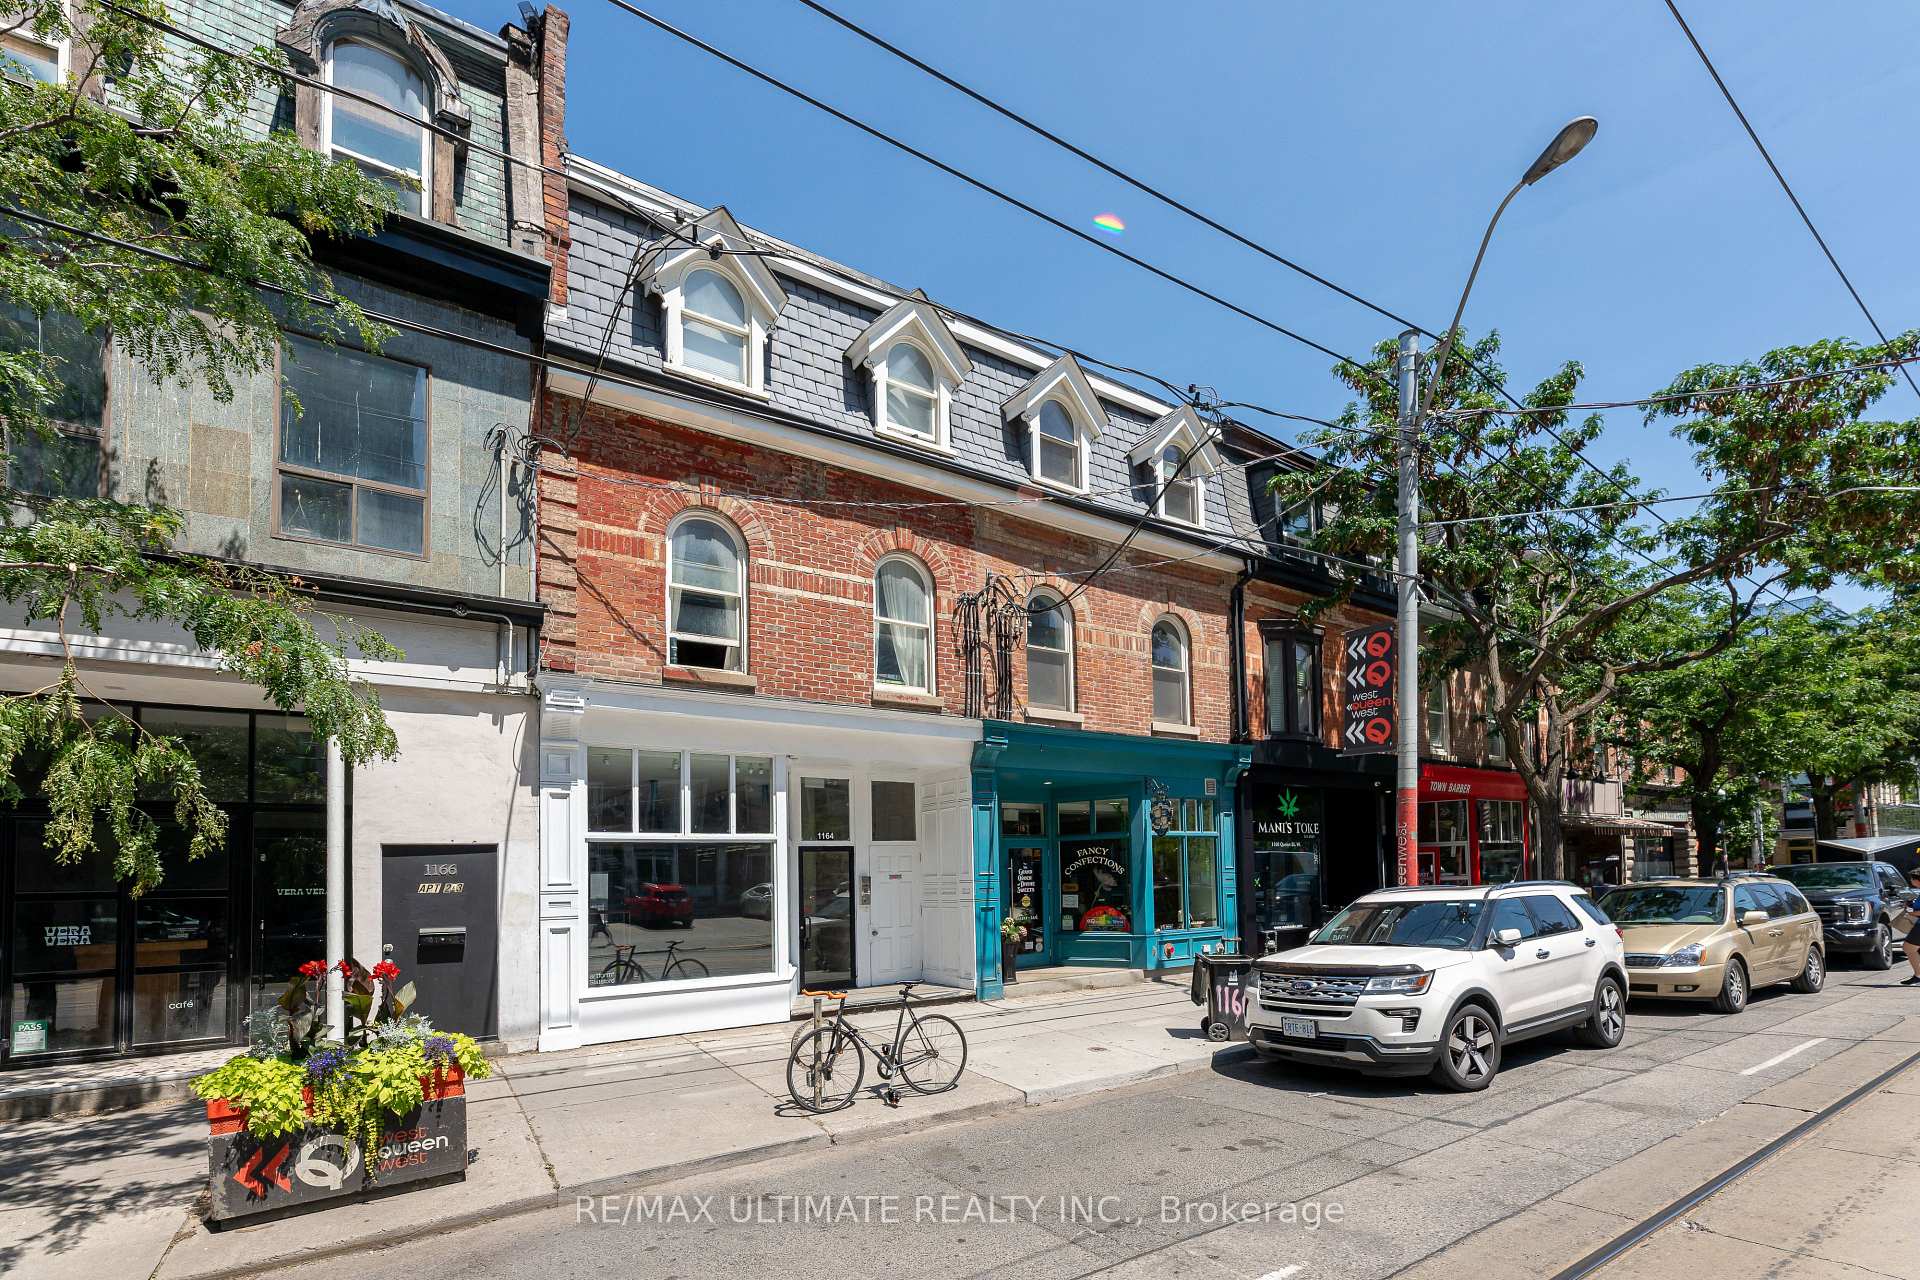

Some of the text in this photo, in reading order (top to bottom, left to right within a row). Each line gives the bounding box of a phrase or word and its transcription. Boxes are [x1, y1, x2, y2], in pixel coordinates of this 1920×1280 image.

[1352, 690, 1378, 701] west
[1352, 707, 1378, 719] west
[1430, 781, 1471, 793] TOWN BARBER
[1258, 821, 1320, 834] MANI'S TOKE
[817, 832, 834, 840] 1164
[1076, 847, 1109, 857] FANCY
[424, 863, 457, 876] 1166
[1064, 856, 1125, 875] CONFECTIONS
[277, 888, 303, 896] VERA
[418, 884, 440, 893] APT
[44, 926, 92, 936] VERA
[44, 936, 92, 946] VERA
[168, 1000, 194, 1010] café
[18, 1023, 42, 1031] PASS
[377, 1126, 429, 1145] west
[377, 1151, 429, 1172] west
